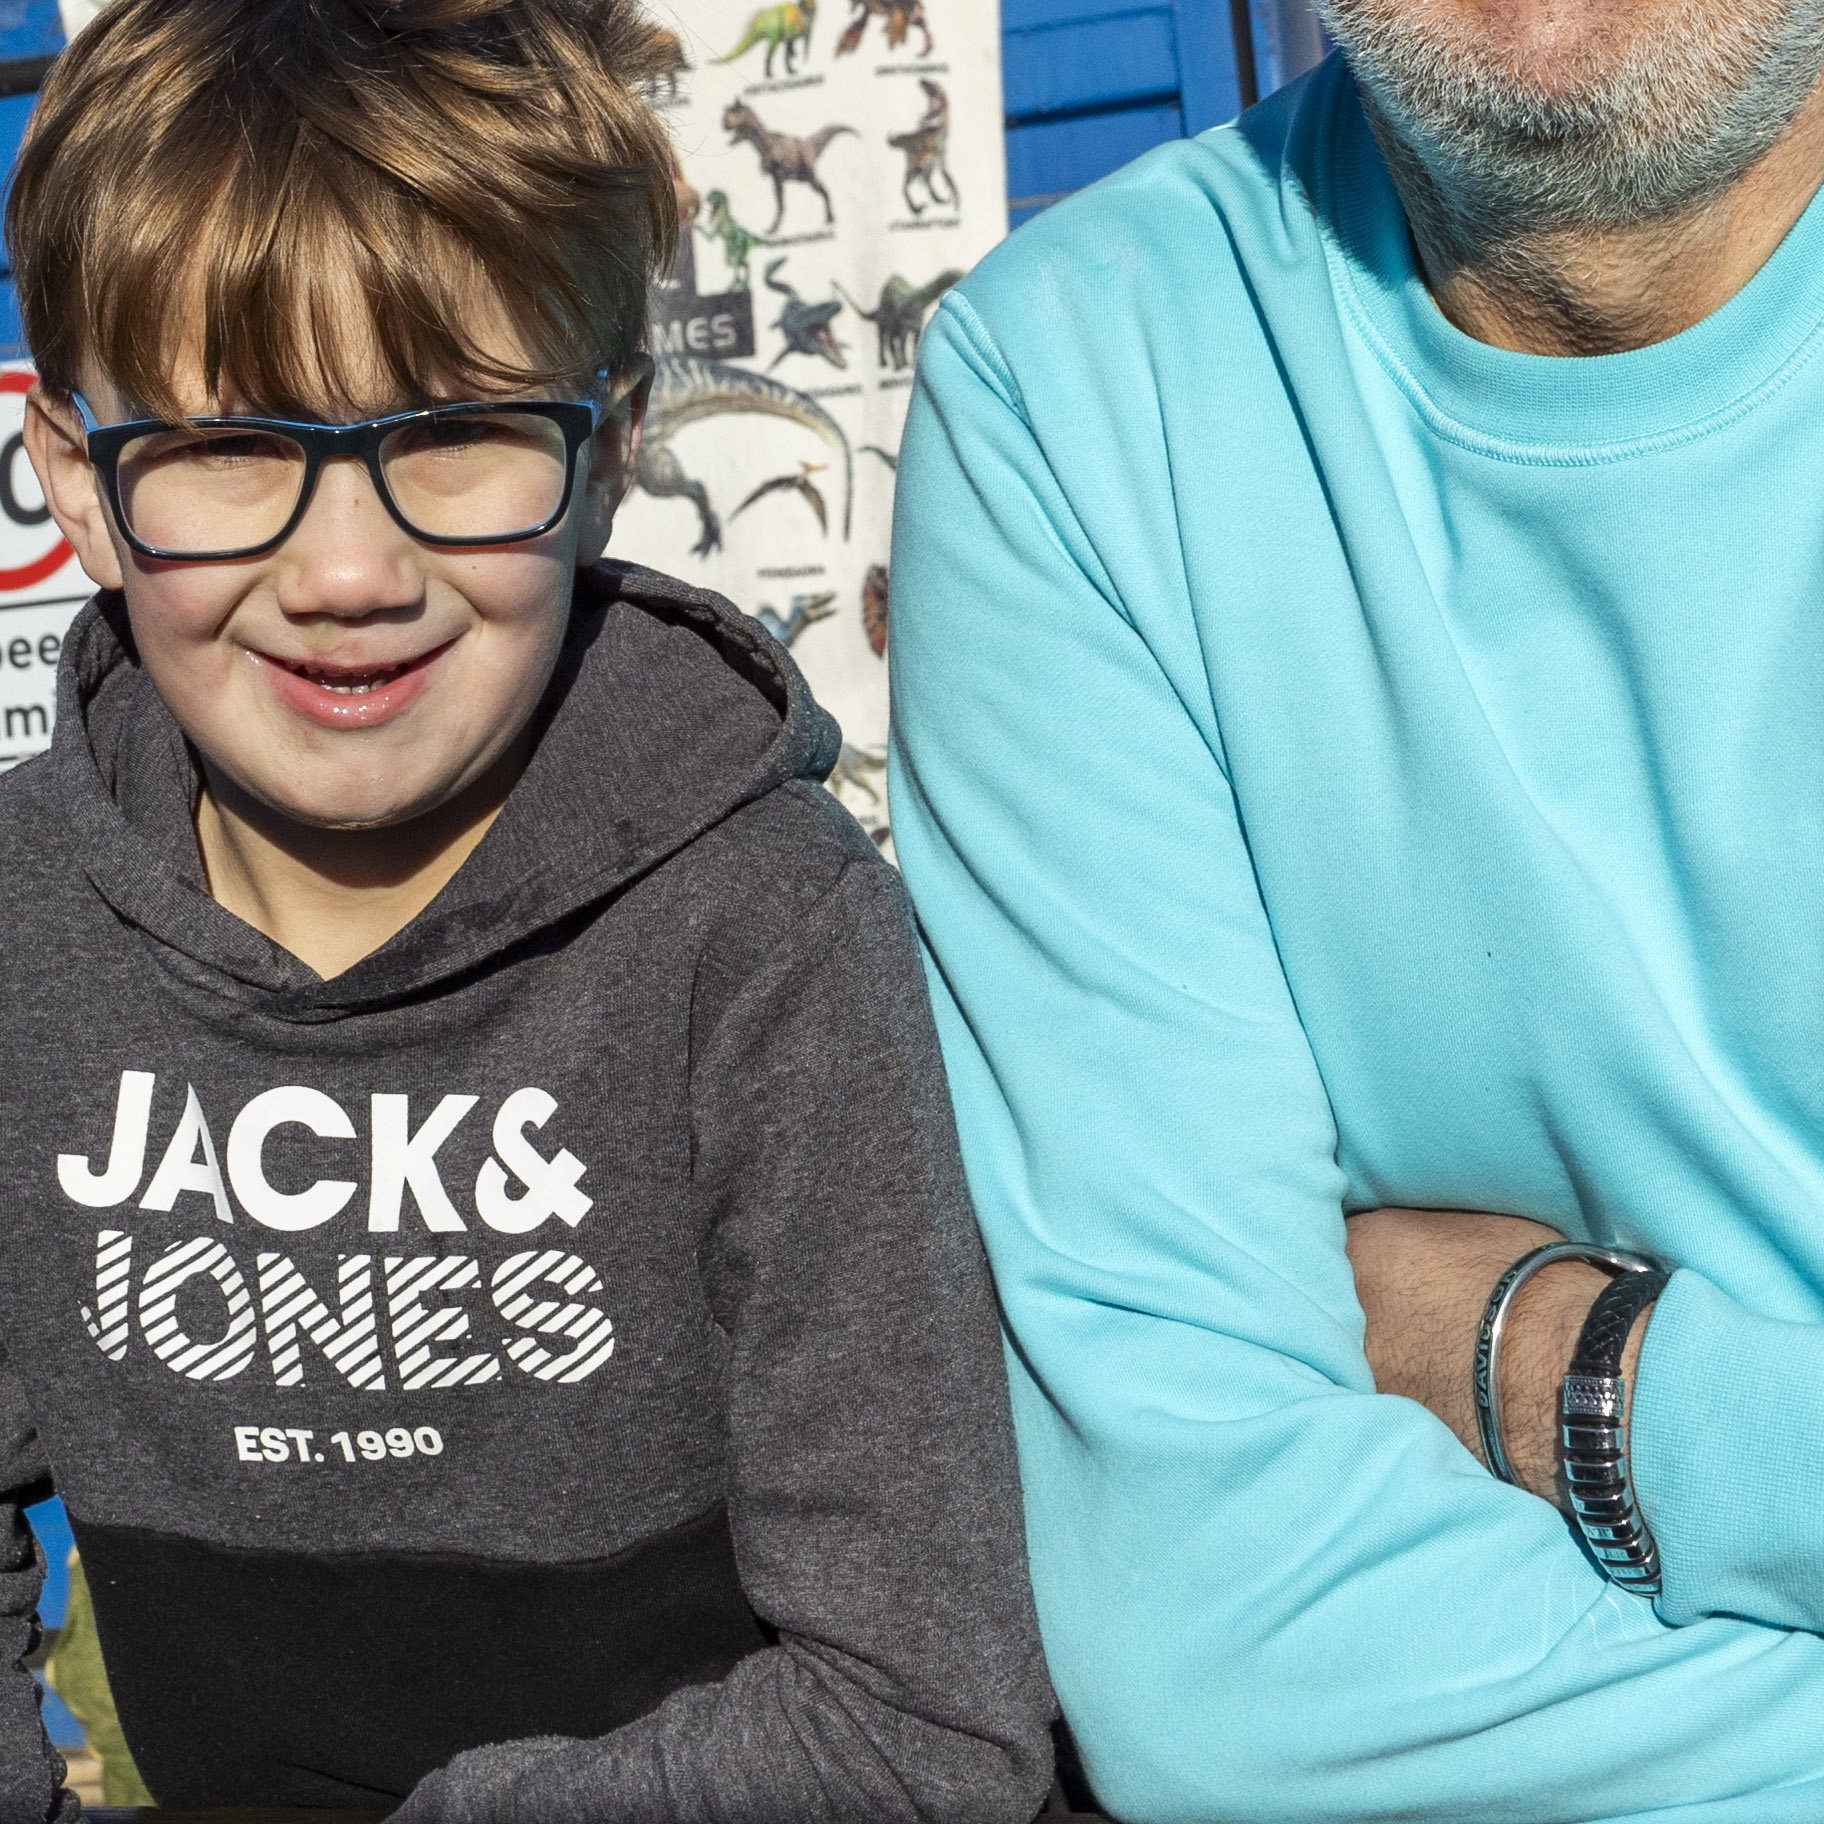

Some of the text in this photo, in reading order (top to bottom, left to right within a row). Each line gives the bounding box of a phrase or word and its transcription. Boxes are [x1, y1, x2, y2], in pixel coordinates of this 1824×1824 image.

[648, 312, 737, 357] MES
[77, 1229, 616, 1391] JONES
[233, 1426, 444, 1463] EST. 1990
